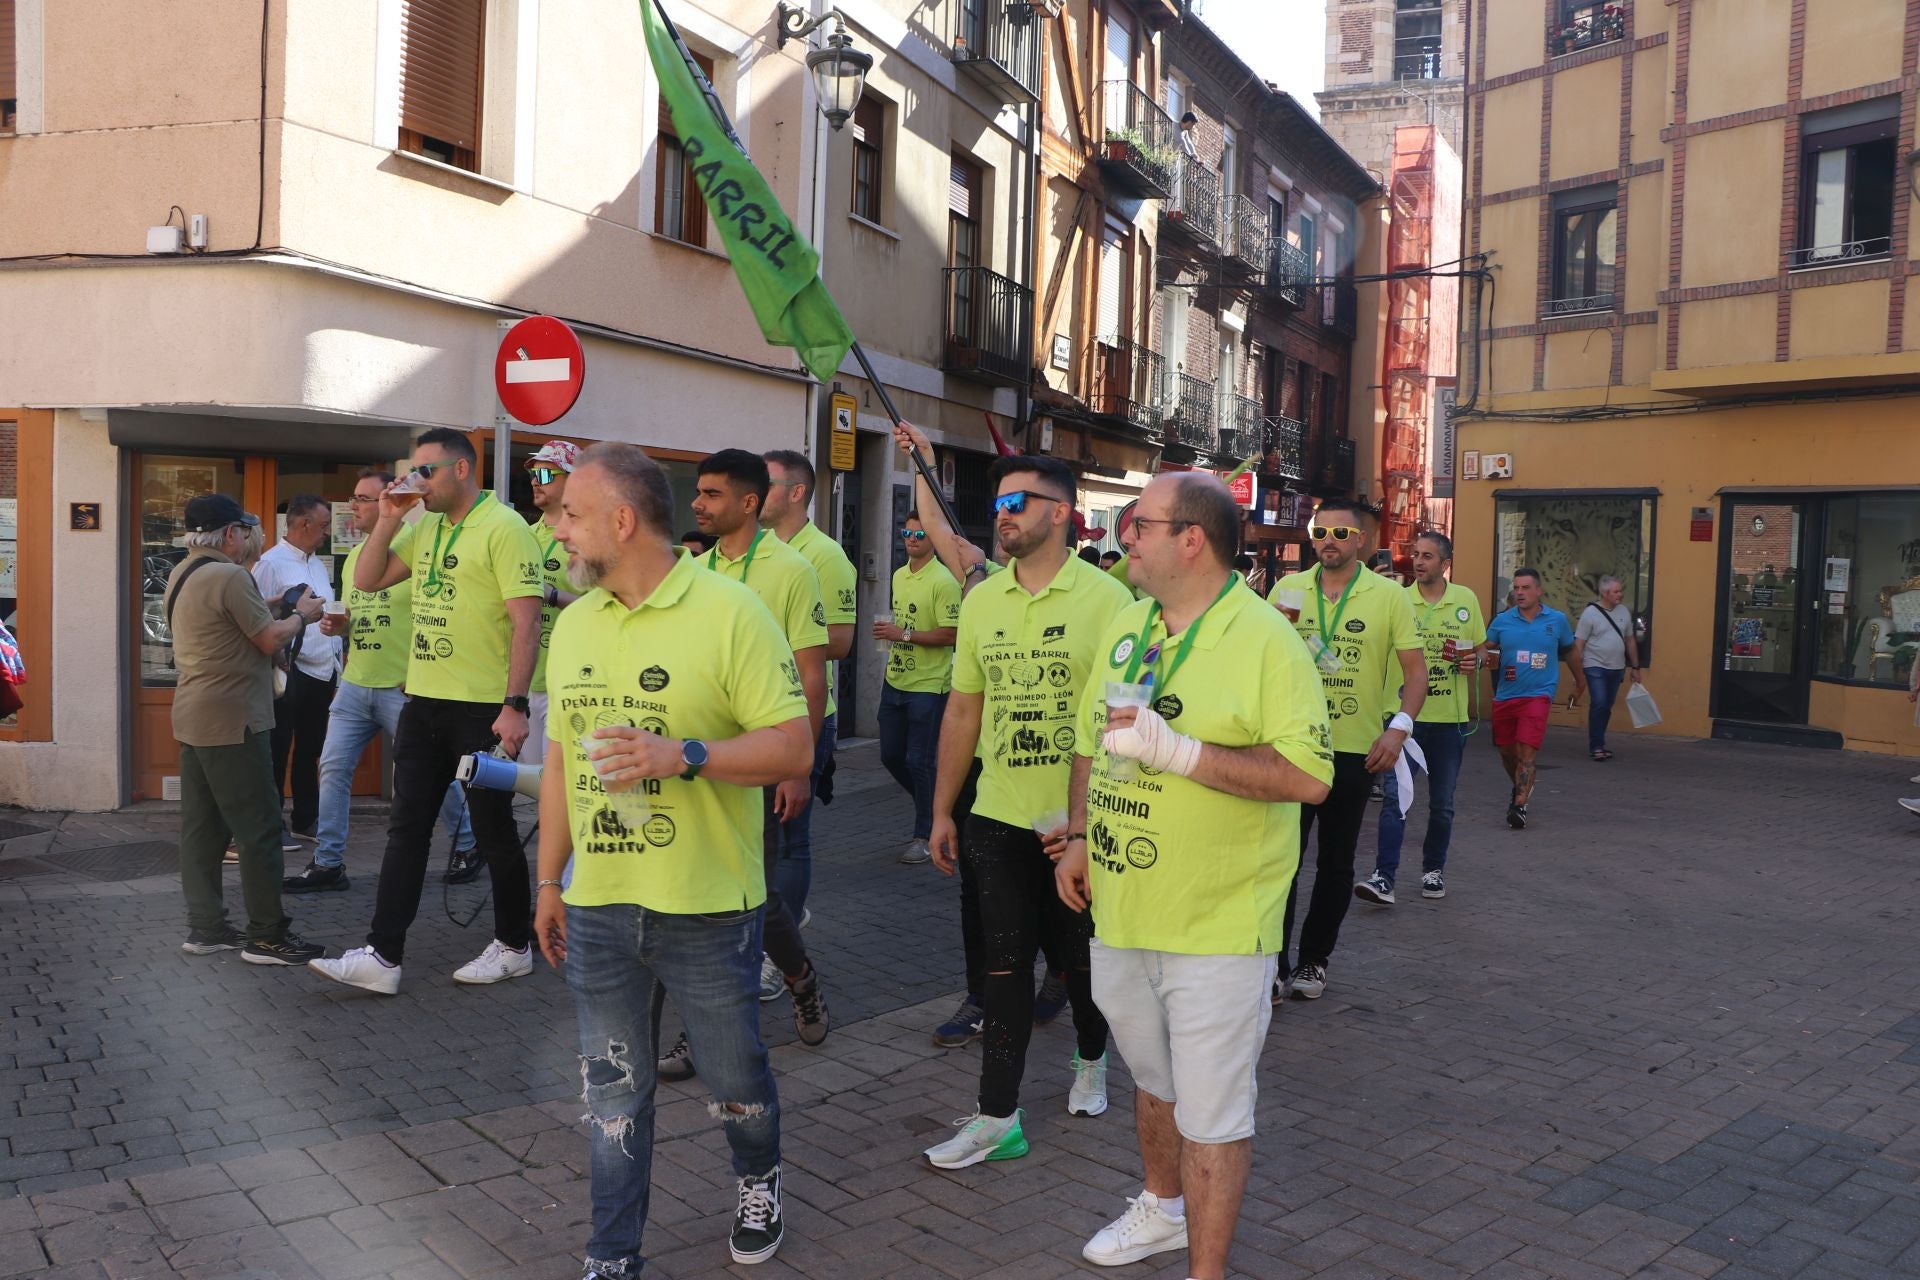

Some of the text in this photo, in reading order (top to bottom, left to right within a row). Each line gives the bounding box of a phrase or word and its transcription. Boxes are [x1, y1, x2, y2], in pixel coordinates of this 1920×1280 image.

[1333, 634, 1364, 645] BARRIL
[982, 650, 1072, 664] PEÑA EL BARRIL
[1322, 677, 1354, 688] NUINA
[1014, 693, 1047, 701] HÚMEDO
[1053, 690, 1074, 700] LEÓN
[560, 694, 669, 714] PEÑA EL BARRIL
[1007, 754, 1062, 769] INSITU
[1137, 780, 1163, 793] LEÓN
[1091, 788, 1150, 820] GENUINA
[586, 841, 646, 855] INSITU
